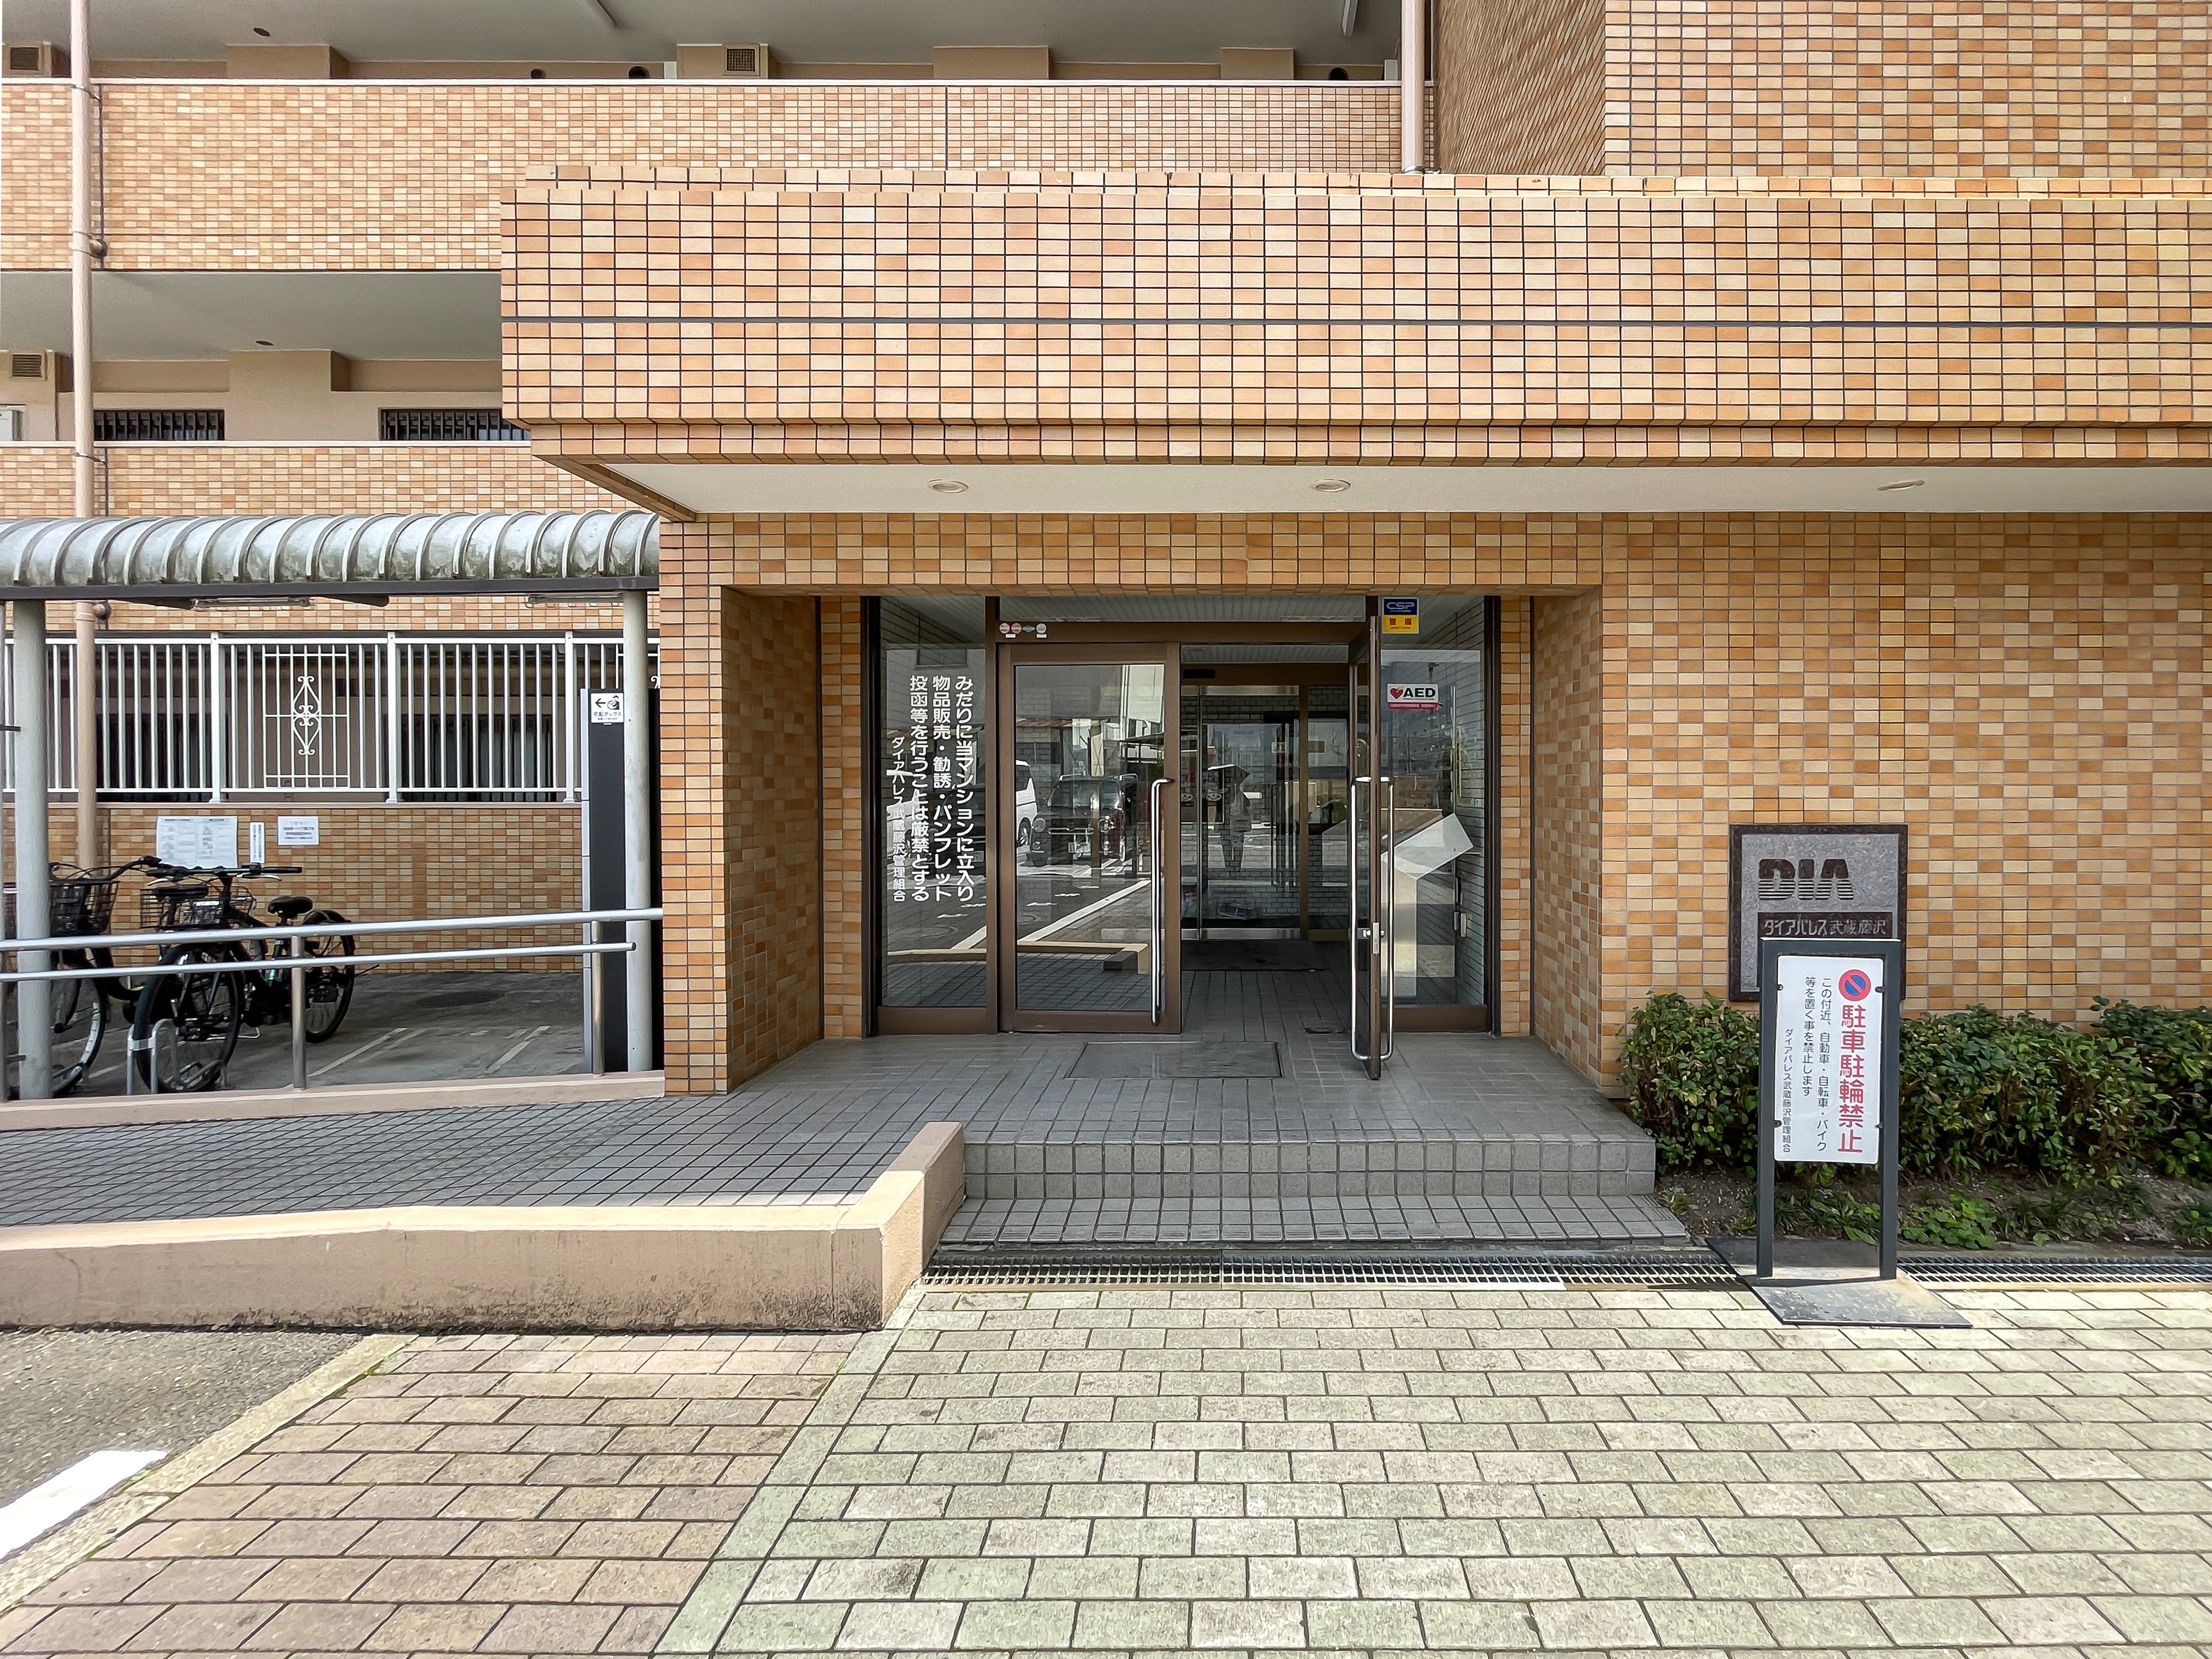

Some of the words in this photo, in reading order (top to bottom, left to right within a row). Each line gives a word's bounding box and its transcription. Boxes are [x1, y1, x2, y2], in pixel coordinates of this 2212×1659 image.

[1403, 687, 1436, 697] AED
[910, 675, 930, 901] 投函等を行うことは厳禁とする
[933, 675, 951, 901] 物品販売・勧誘・パンフレット
[955, 676, 974, 901] みだりに当マンションに立入り
[1758, 859, 1854, 900] DIA
[1802, 977, 1816, 1096] 等を置く事を禁止します
[1837, 1005, 1866, 1153] 駐車駐輪禁止
